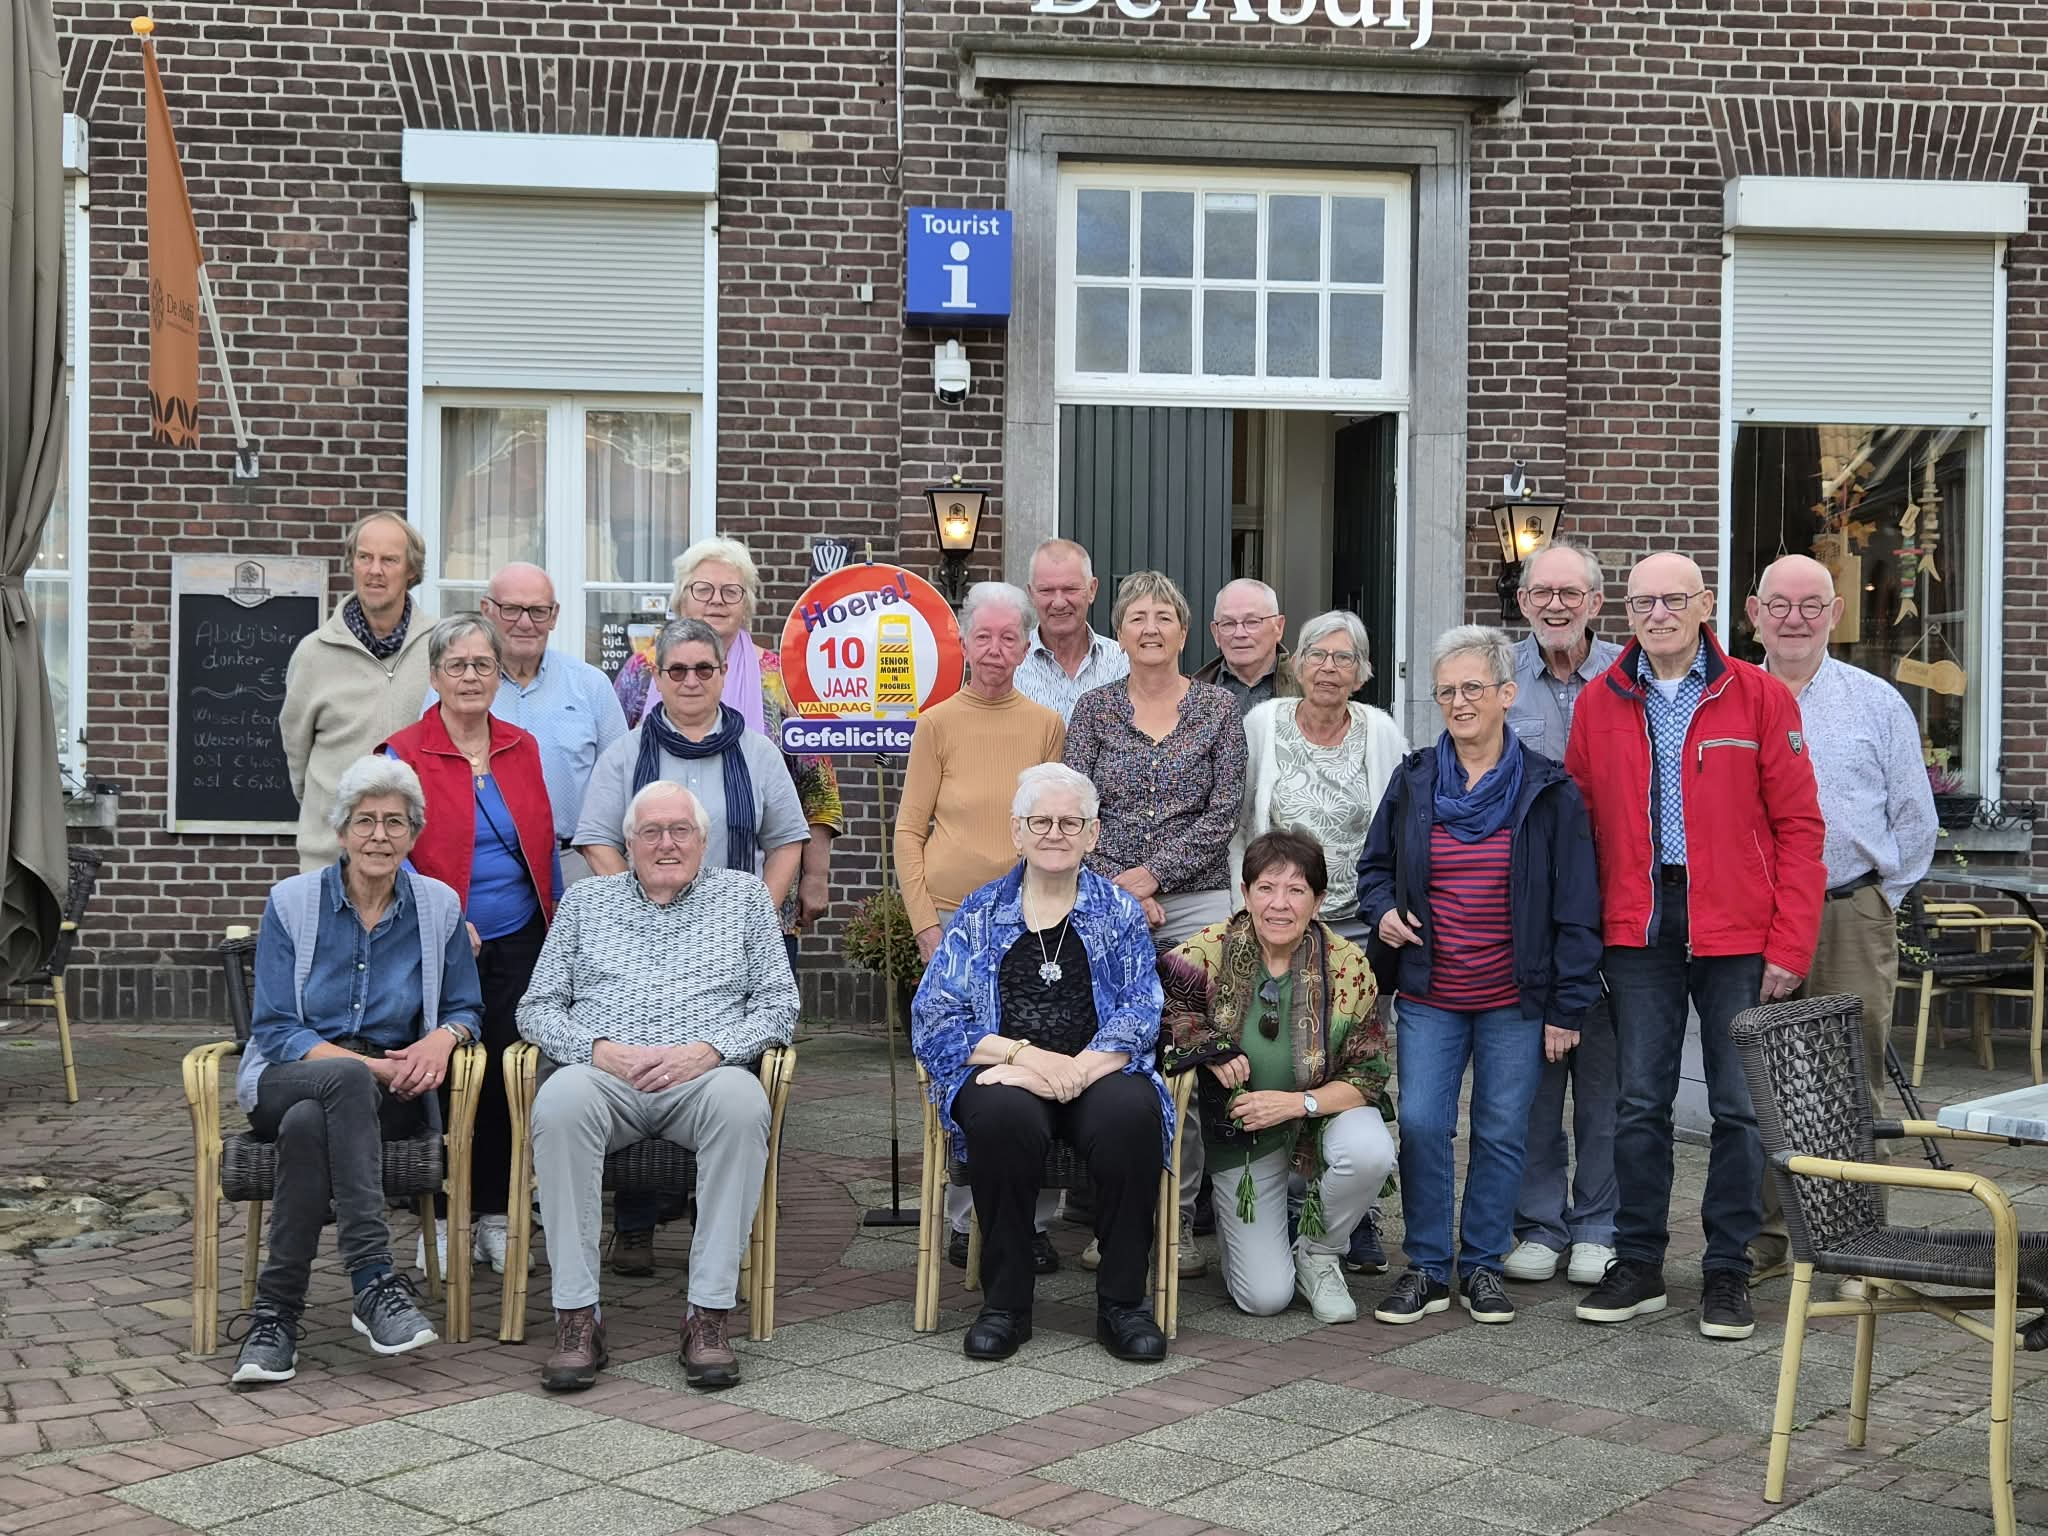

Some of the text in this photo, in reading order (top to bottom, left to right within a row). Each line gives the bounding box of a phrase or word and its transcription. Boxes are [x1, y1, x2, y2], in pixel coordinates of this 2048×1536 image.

[921, 213, 1000, 236] Tourist
[167, 293, 178, 316] De
[800, 572, 911, 633] Hoera!
[602, 623, 625, 634] Alle
[602, 636, 625, 649] tijd.
[201, 647, 265, 670] donker
[602, 650, 629, 659] voor
[819, 636, 865, 669] 10
[602, 660, 619, 671] 0.0
[880, 656, 909, 665] SENIOR
[880, 666, 910, 674] MOMENT
[891, 674, 899, 682] IN
[822, 677, 869, 698] JAAR
[799, 702, 872, 713] VANDAAG
[784, 726, 914, 748] Gefelicite
